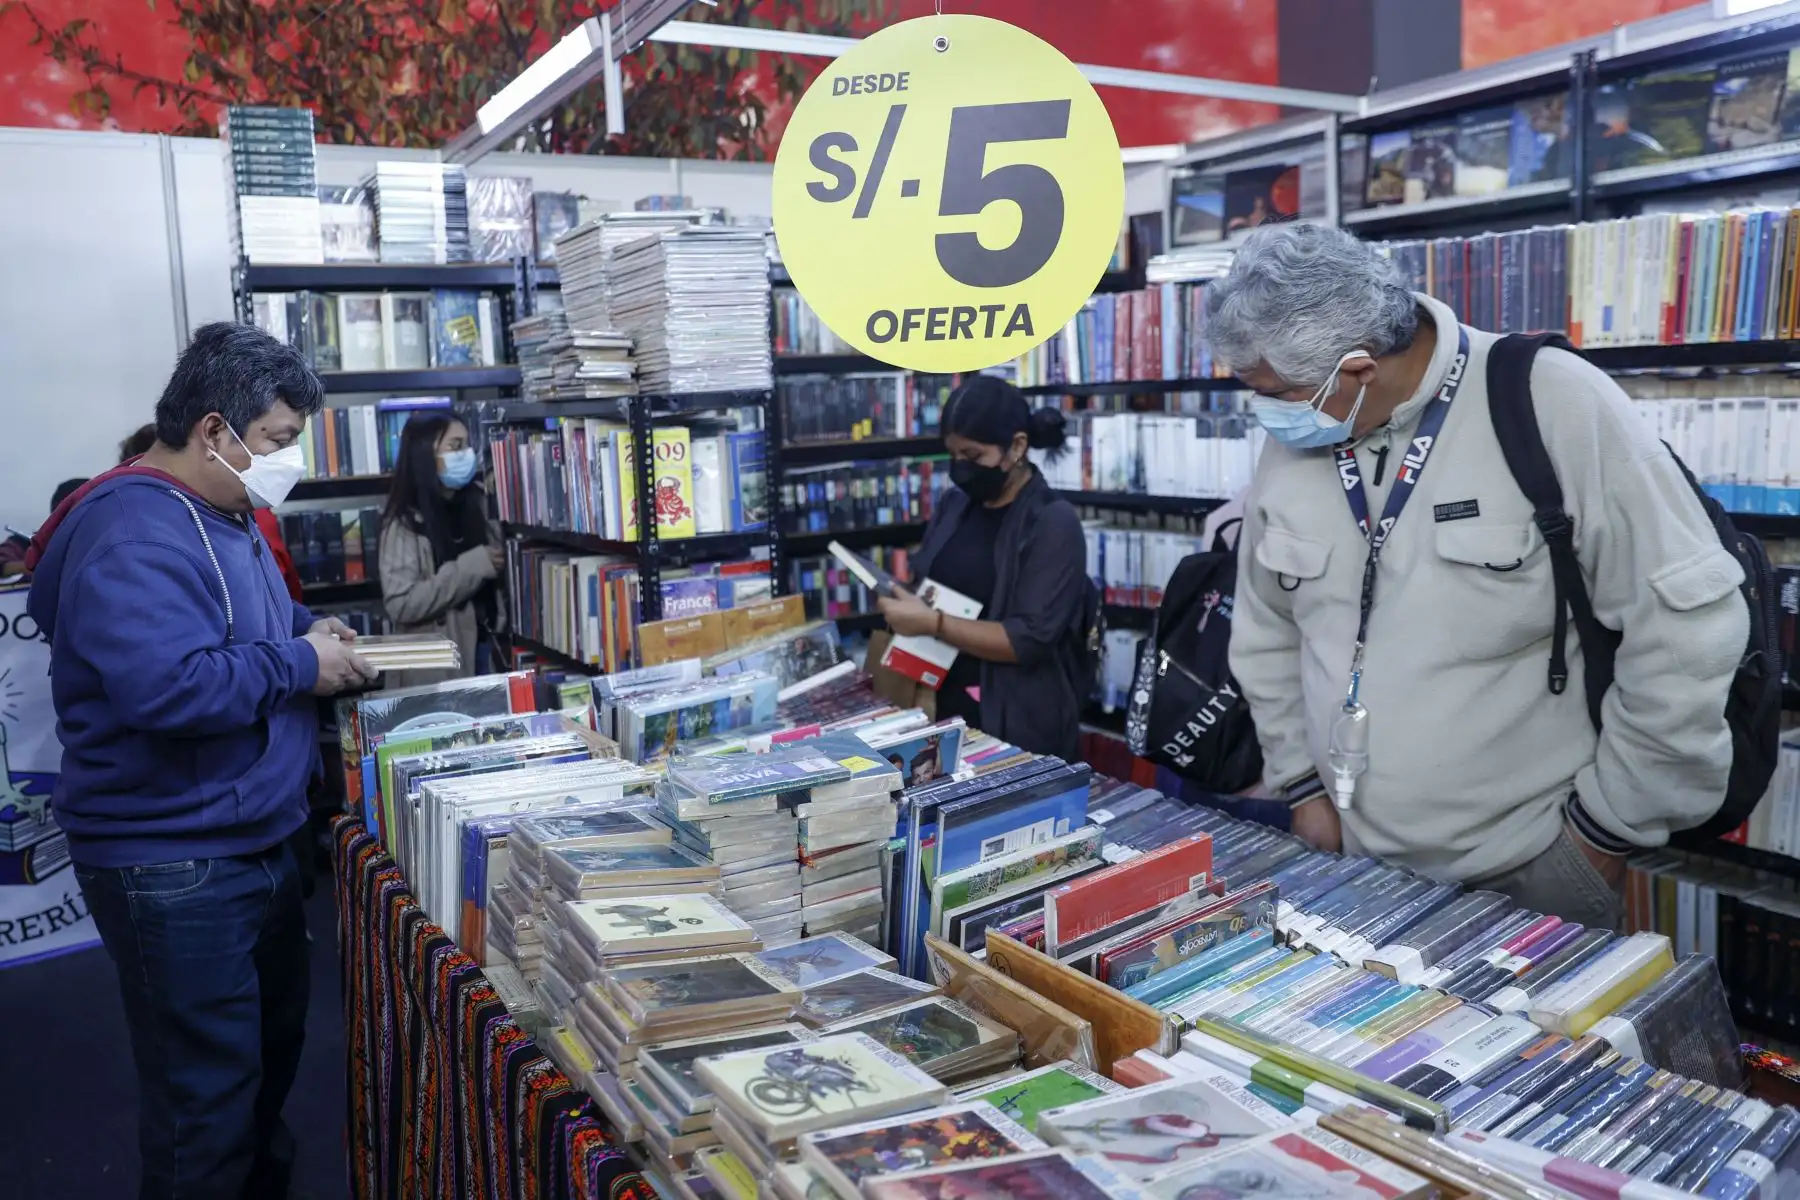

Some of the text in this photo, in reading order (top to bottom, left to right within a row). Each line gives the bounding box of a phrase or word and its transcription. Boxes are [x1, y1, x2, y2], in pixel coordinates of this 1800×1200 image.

[832, 71, 911, 97] DESDE
[866, 303, 1035, 344] OFERTA
[1436, 353, 1466, 403] FILA
[1397, 435, 1434, 485] FILA
[663, 595, 712, 612] France
[0, 890, 90, 947] RERÍ
